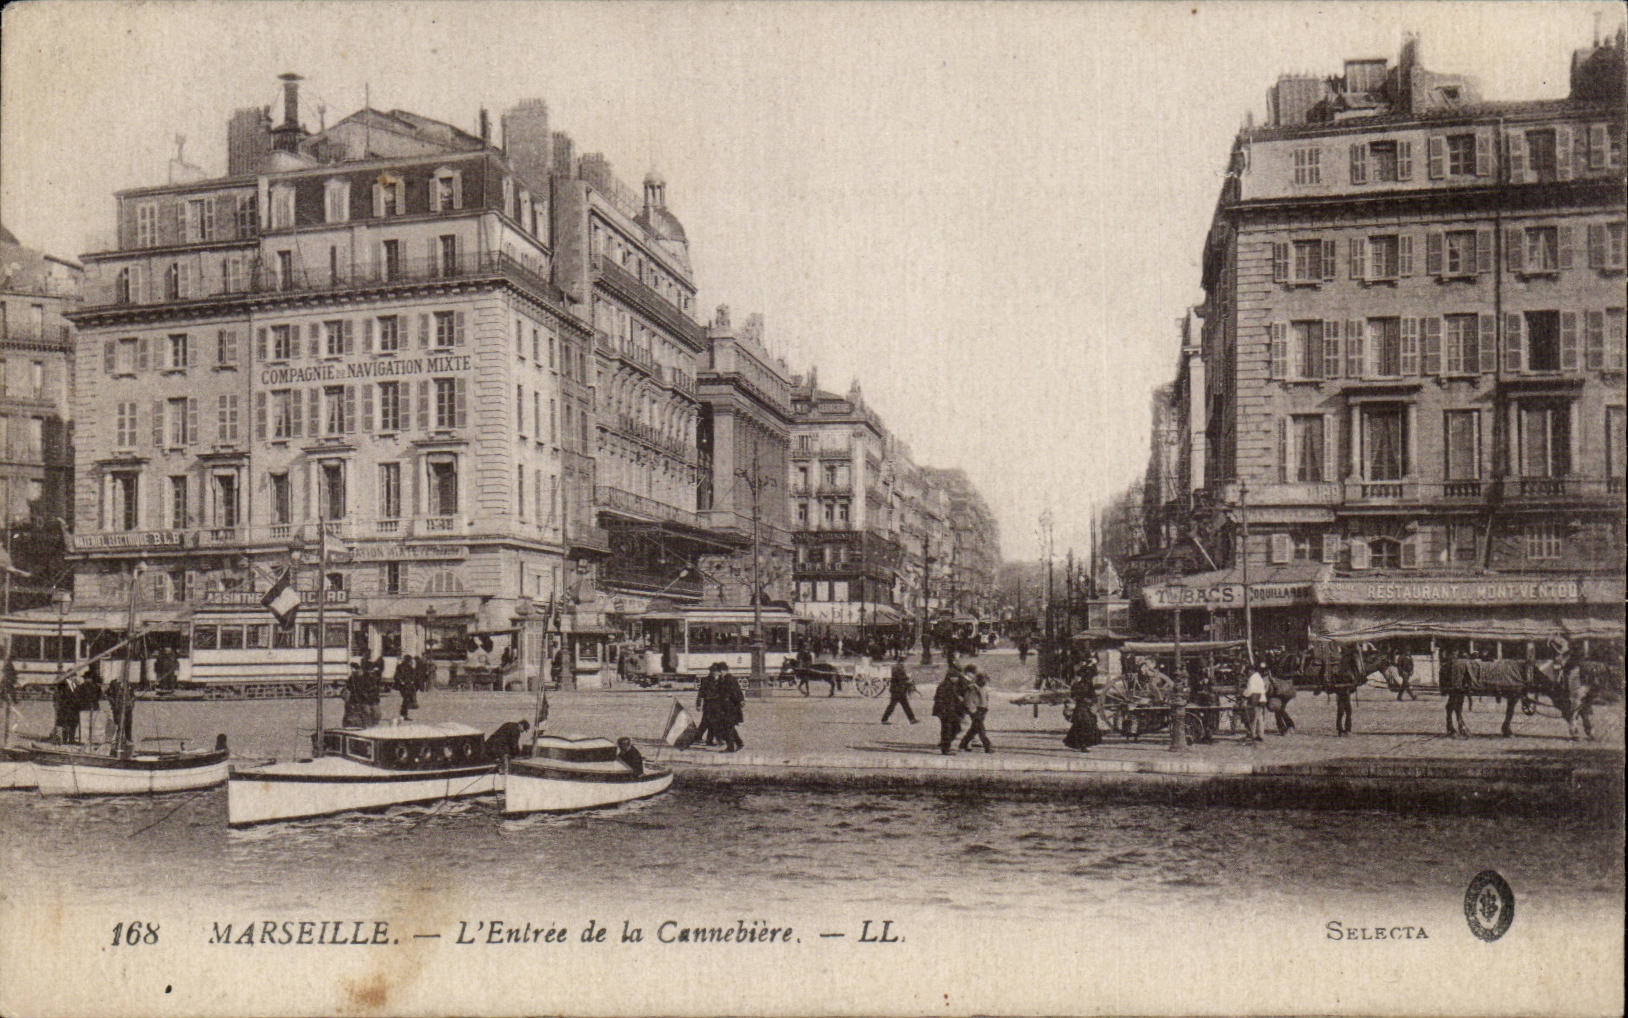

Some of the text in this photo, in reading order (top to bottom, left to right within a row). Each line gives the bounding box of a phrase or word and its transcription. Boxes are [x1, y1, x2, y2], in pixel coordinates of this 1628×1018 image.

[261, 364, 335, 385] COMPAGNIE
[347, 358, 423, 378] NAVIGATION
[427, 355, 471, 373] MIXTE
[206, 592, 263, 604] ABSINTHE
[1367, 584, 1458, 599] RESTAURANT
